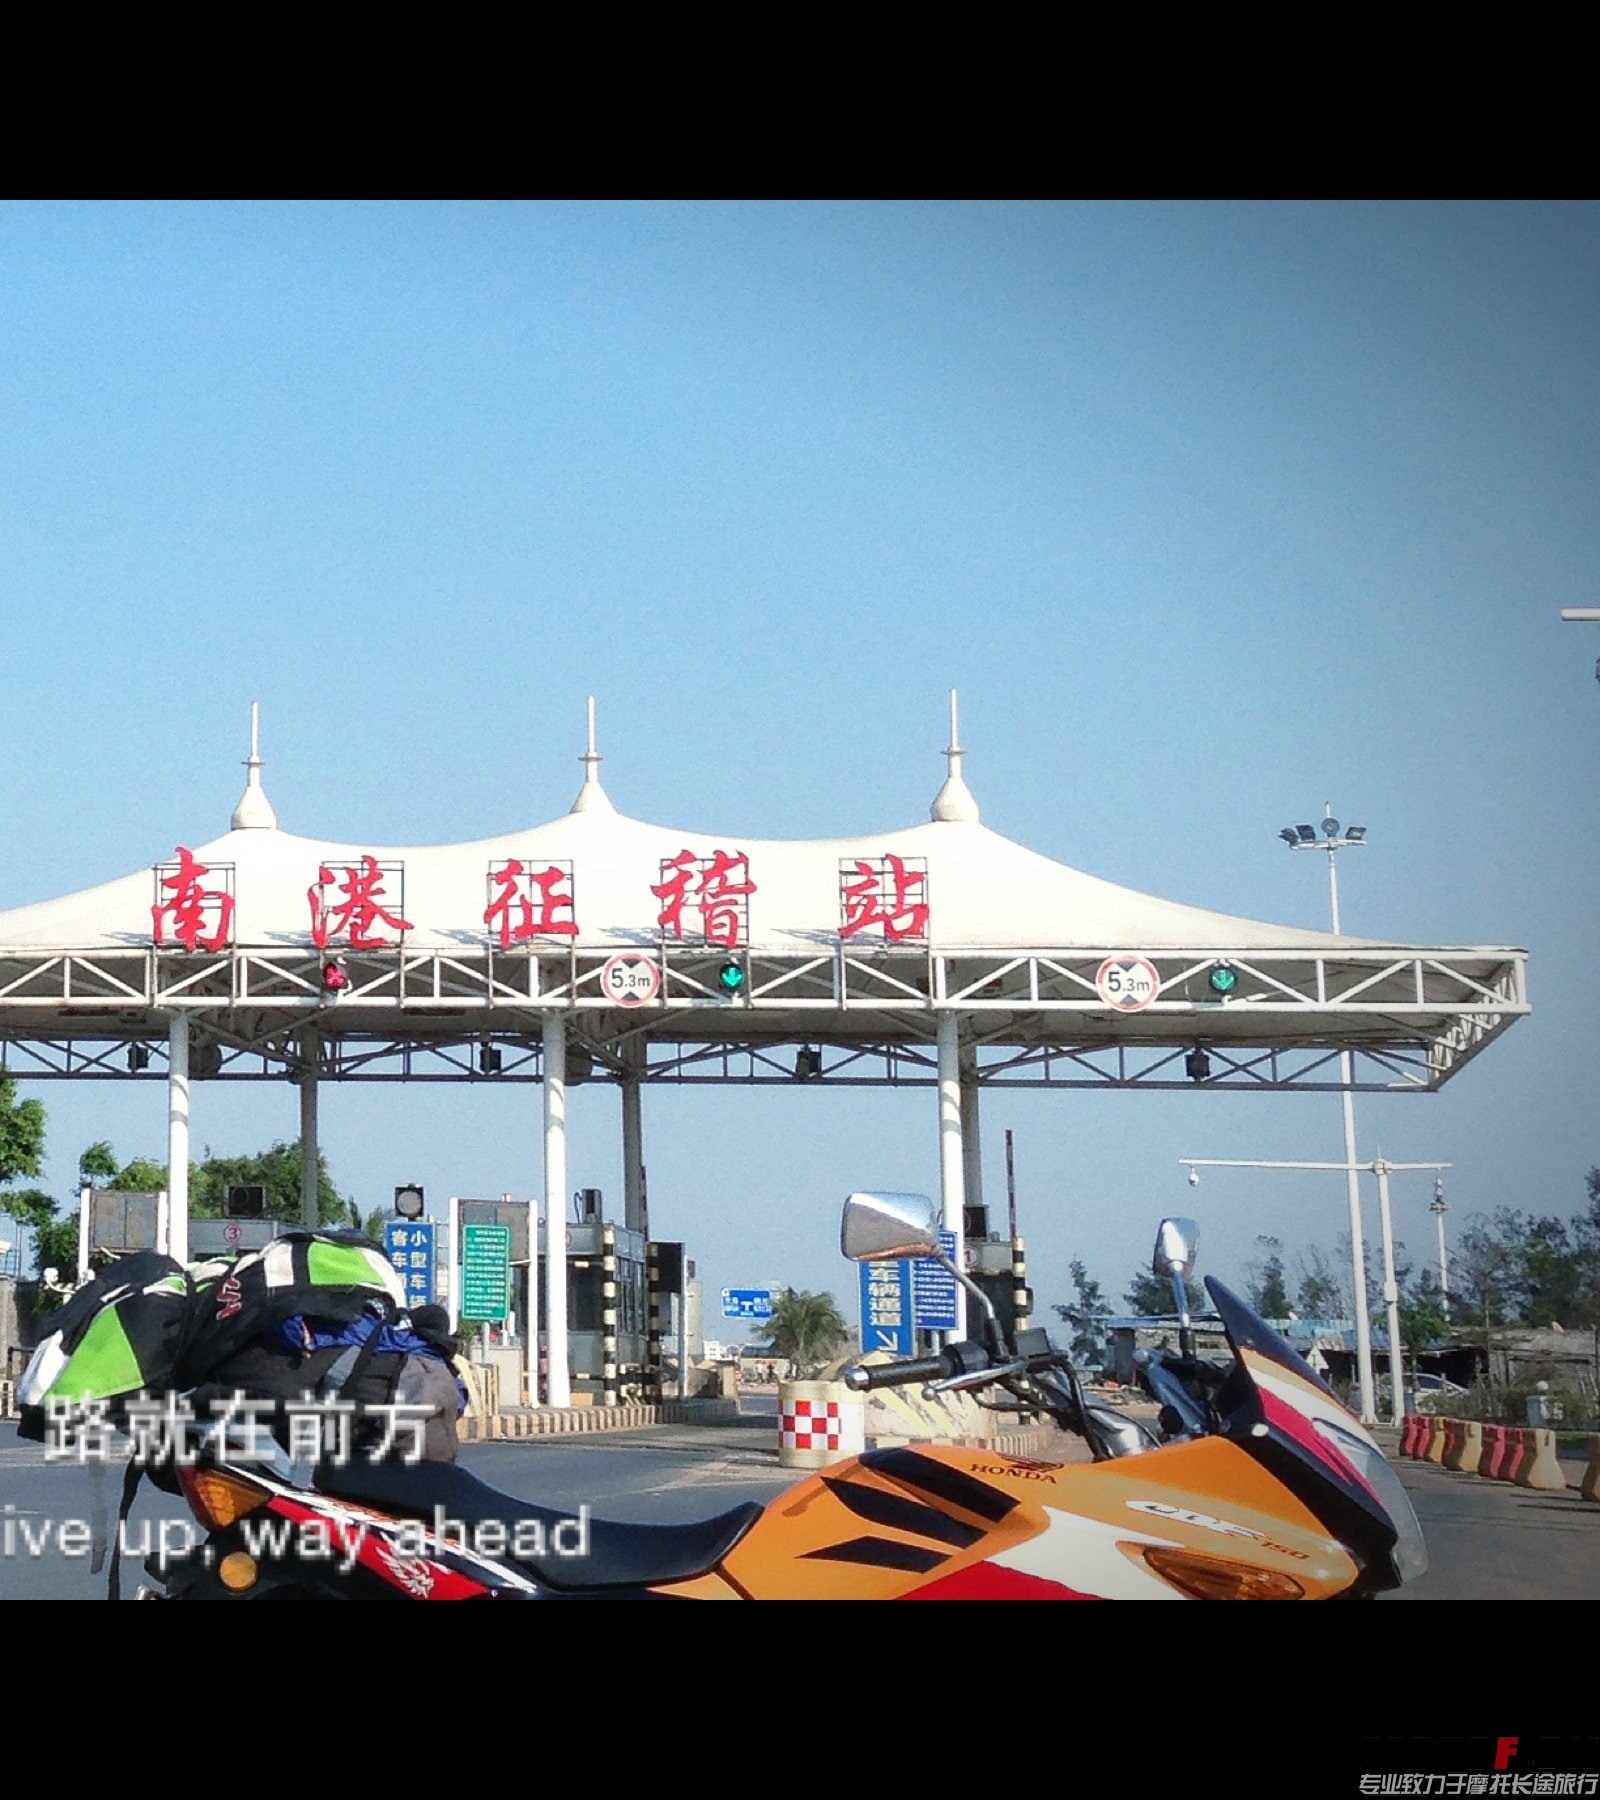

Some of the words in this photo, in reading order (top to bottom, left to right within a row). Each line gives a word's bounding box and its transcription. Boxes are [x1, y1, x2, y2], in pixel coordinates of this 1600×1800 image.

[151, 846, 931, 952] 南港征稽站
[611, 967, 651, 989] 5.3m
[1107, 971, 1150, 993] 5.3m
[970, 1464, 1057, 1484] HONDA
[1260, 1540, 1311, 1561] 150
